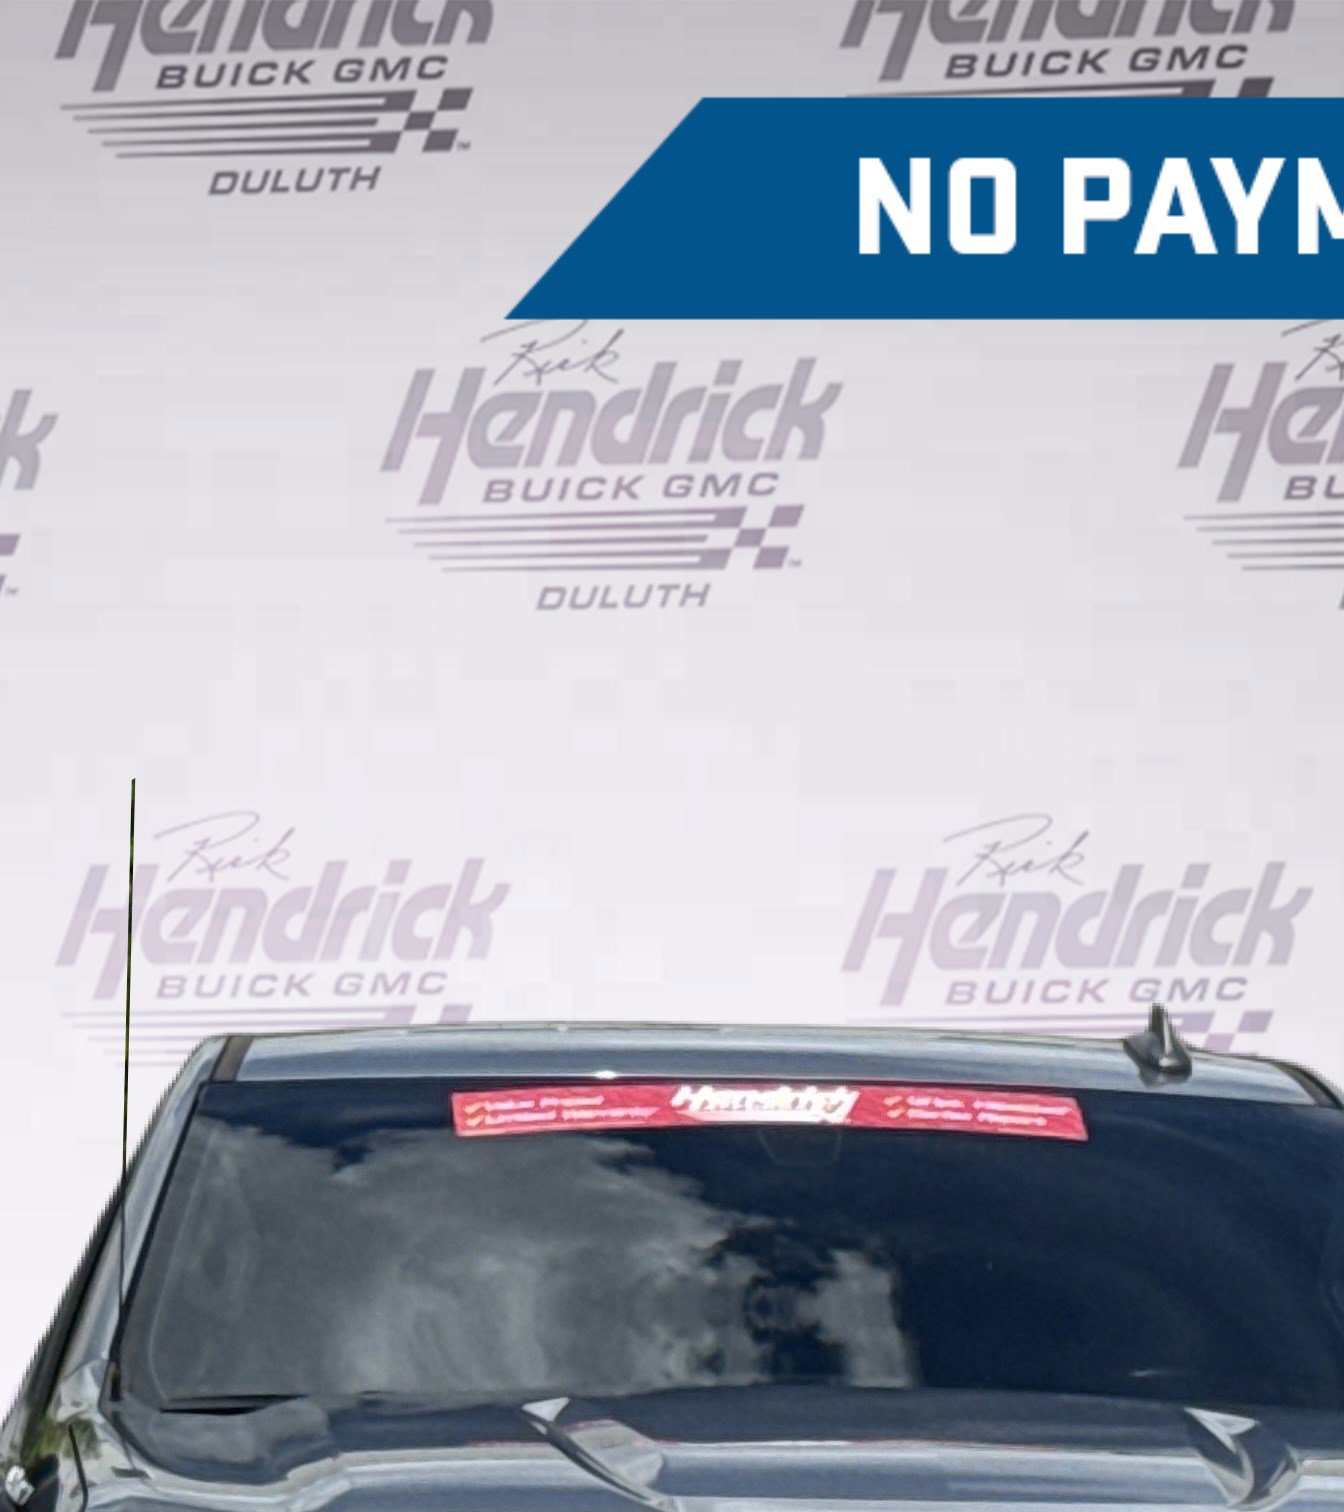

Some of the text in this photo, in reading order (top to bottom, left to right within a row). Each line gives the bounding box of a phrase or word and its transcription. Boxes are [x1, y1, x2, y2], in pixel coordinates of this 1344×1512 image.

[155, 55, 449, 90] BUICK GMC
[944, 44, 1249, 79] BUICK GMC
[208, 165, 382, 195] DULUTH
[379, 357, 844, 506] Hendrick
[482, 472, 780, 503] BUICK GMC
[536, 582, 712, 611] DULUTH
[54, 857, 511, 1000] Hendrick
[840, 861, 1314, 1007] Hendrick
[155, 970, 449, 999] BUICK GMC
[945, 976, 1249, 1006] BUICK GMC
